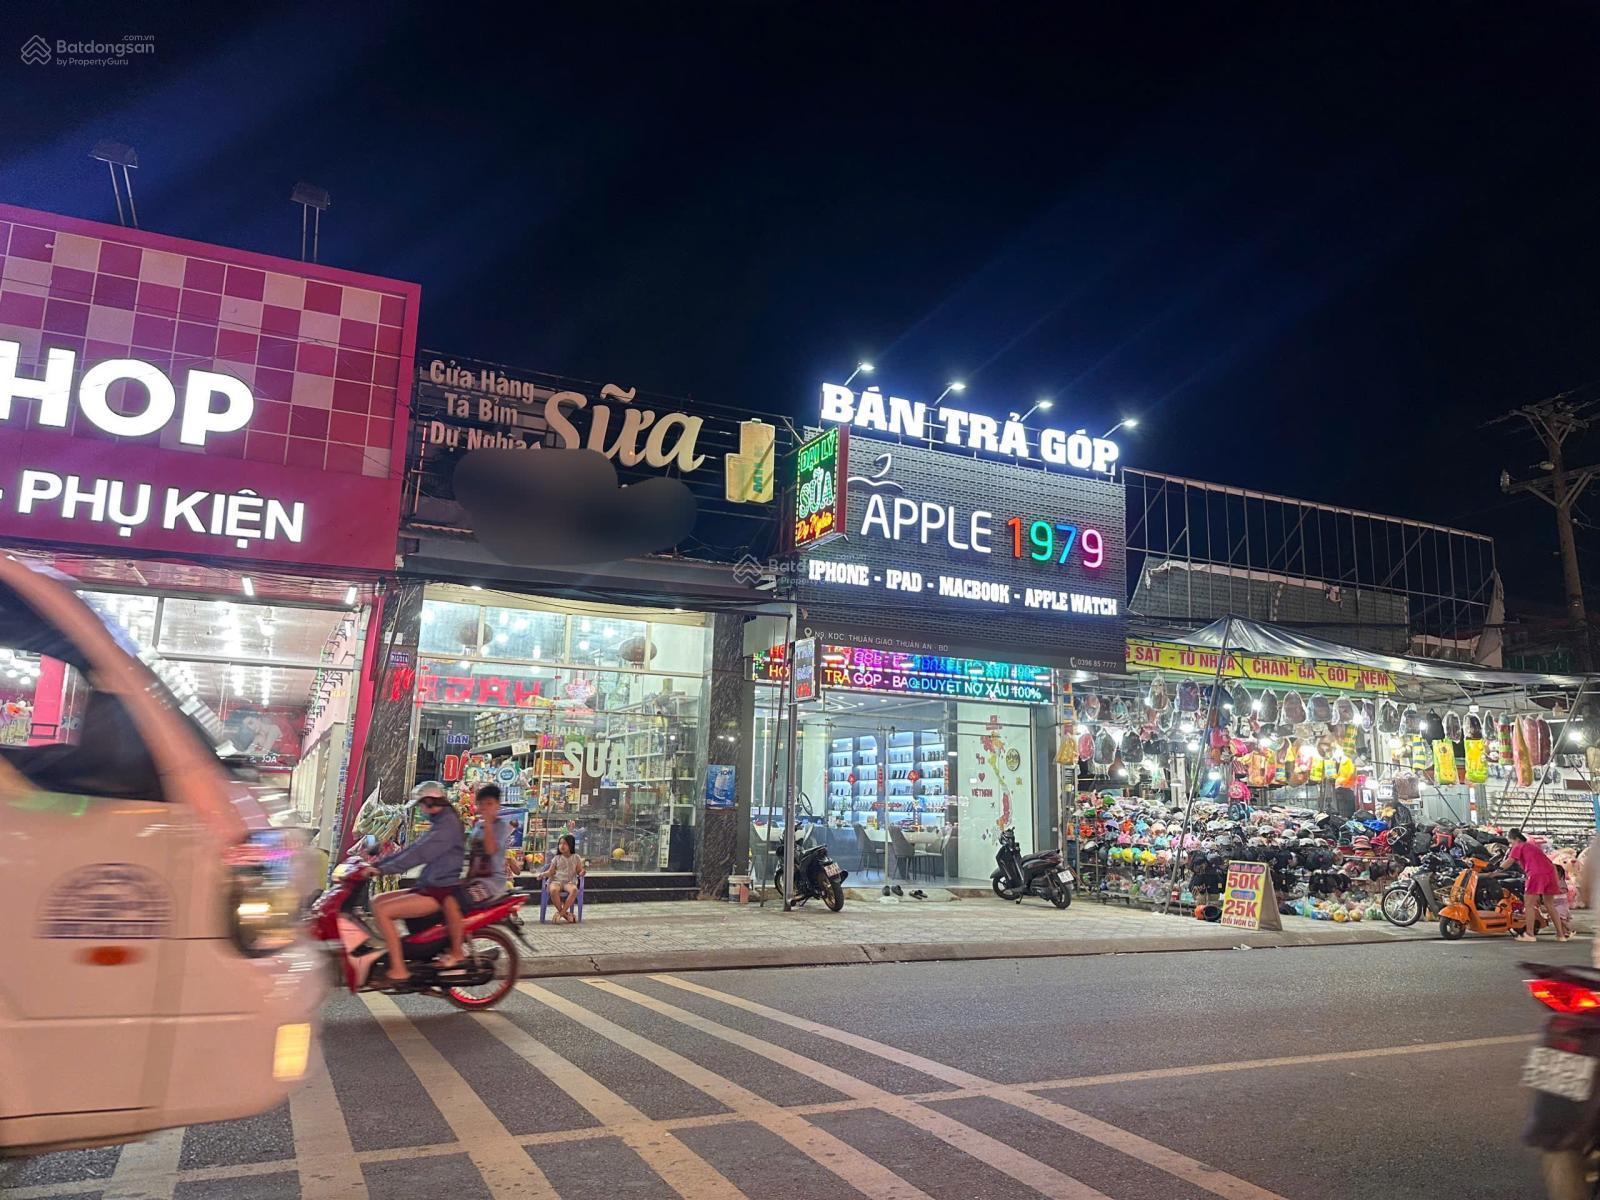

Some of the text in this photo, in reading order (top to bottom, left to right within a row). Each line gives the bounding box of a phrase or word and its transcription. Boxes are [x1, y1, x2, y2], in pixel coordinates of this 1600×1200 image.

[430, 359, 534, 405] Cửa Hàng
[430, 420, 462, 452] Dự
[820, 382, 1120, 475] BÁN TRẢ GÓP
[18, 468, 305, 549] PHỤ KIỆN
[860, 493, 1105, 569] APPLE 1979
[808, 558, 870, 586] IPHONE
[885, 568, 923, 592] IPAD
[938, 576, 1010, 604] MACBOOK
[1024, 587, 1068, 612] APPLE
[1070, 593, 1118, 616] WATCH
[875, 637, 893, 646] GIAO
[922, 643, 933, 651] AN
[1227, 873, 1261, 890] 50K
[1223, 899, 1258, 918] 25K
